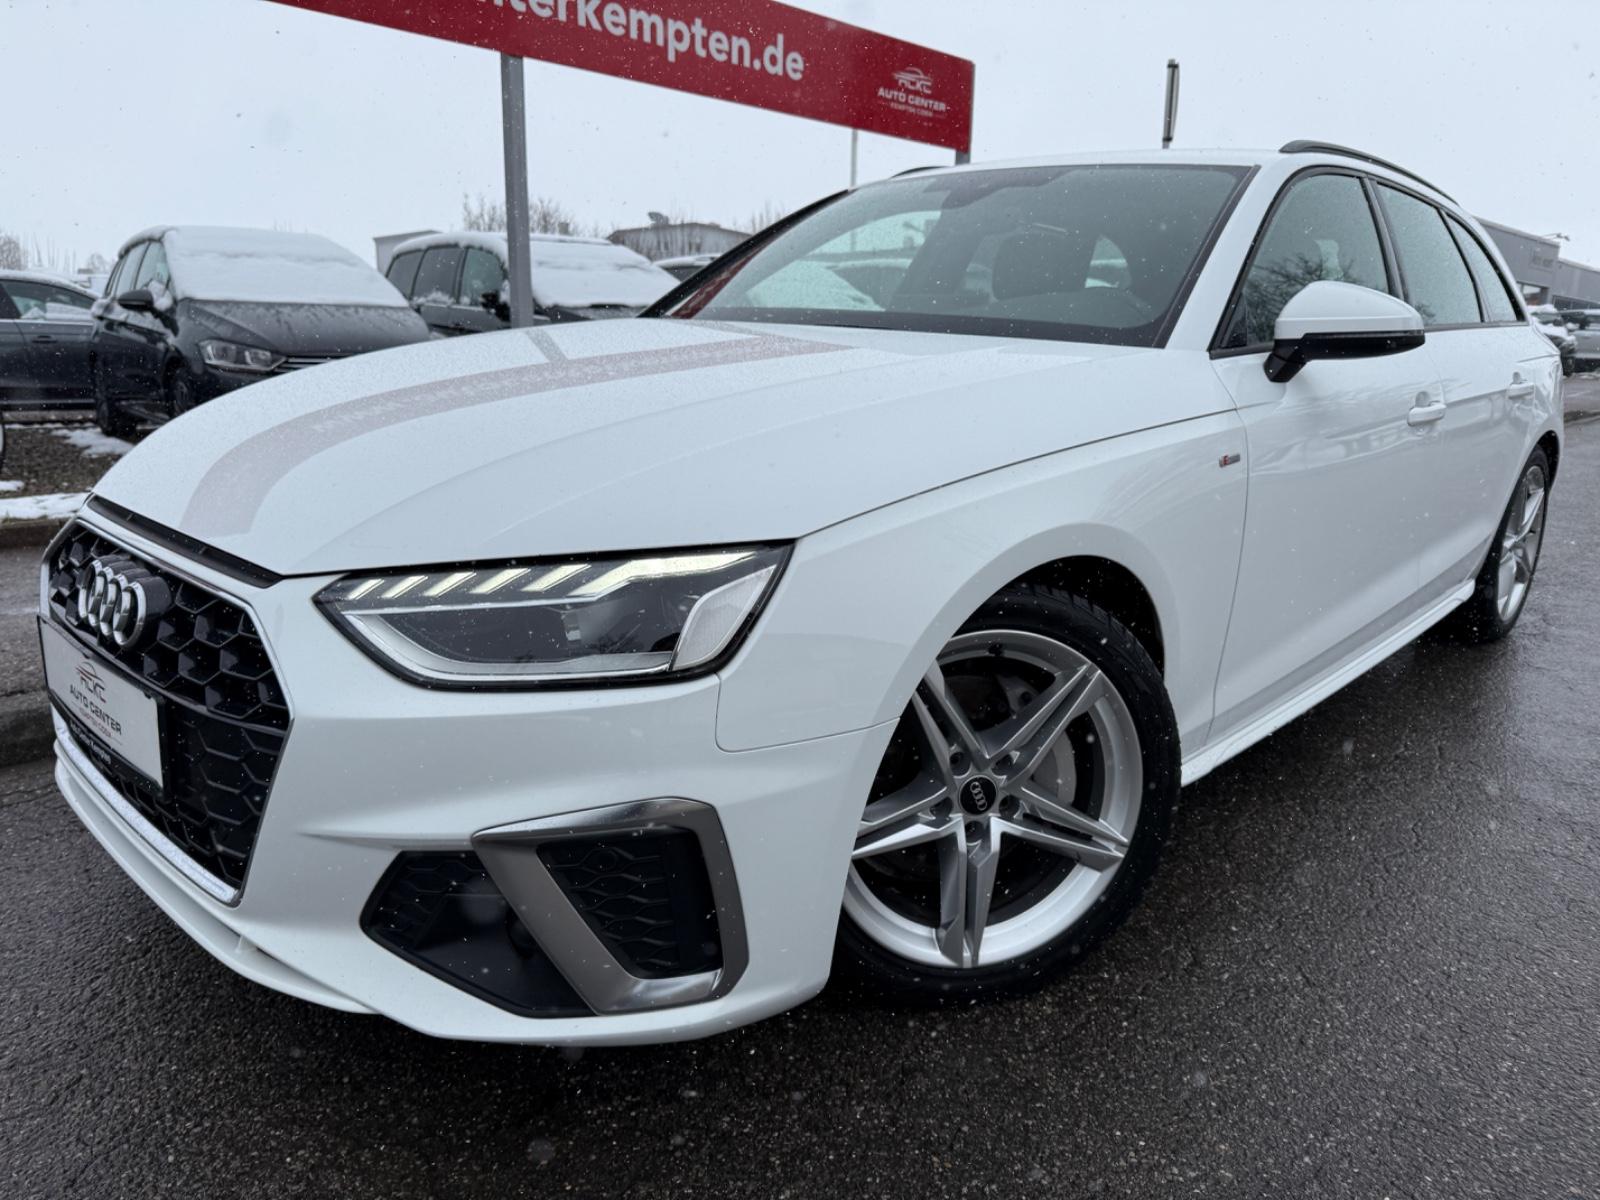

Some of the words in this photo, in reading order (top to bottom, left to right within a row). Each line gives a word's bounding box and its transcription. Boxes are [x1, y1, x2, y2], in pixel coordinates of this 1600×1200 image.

[480, 0, 804, 81] erkempten.de
[877, 86, 907, 104] AUTO
[907, 93, 947, 113] CENTER
[70, 683, 90, 709] AUTO
[89, 700, 122, 736] CENTER
